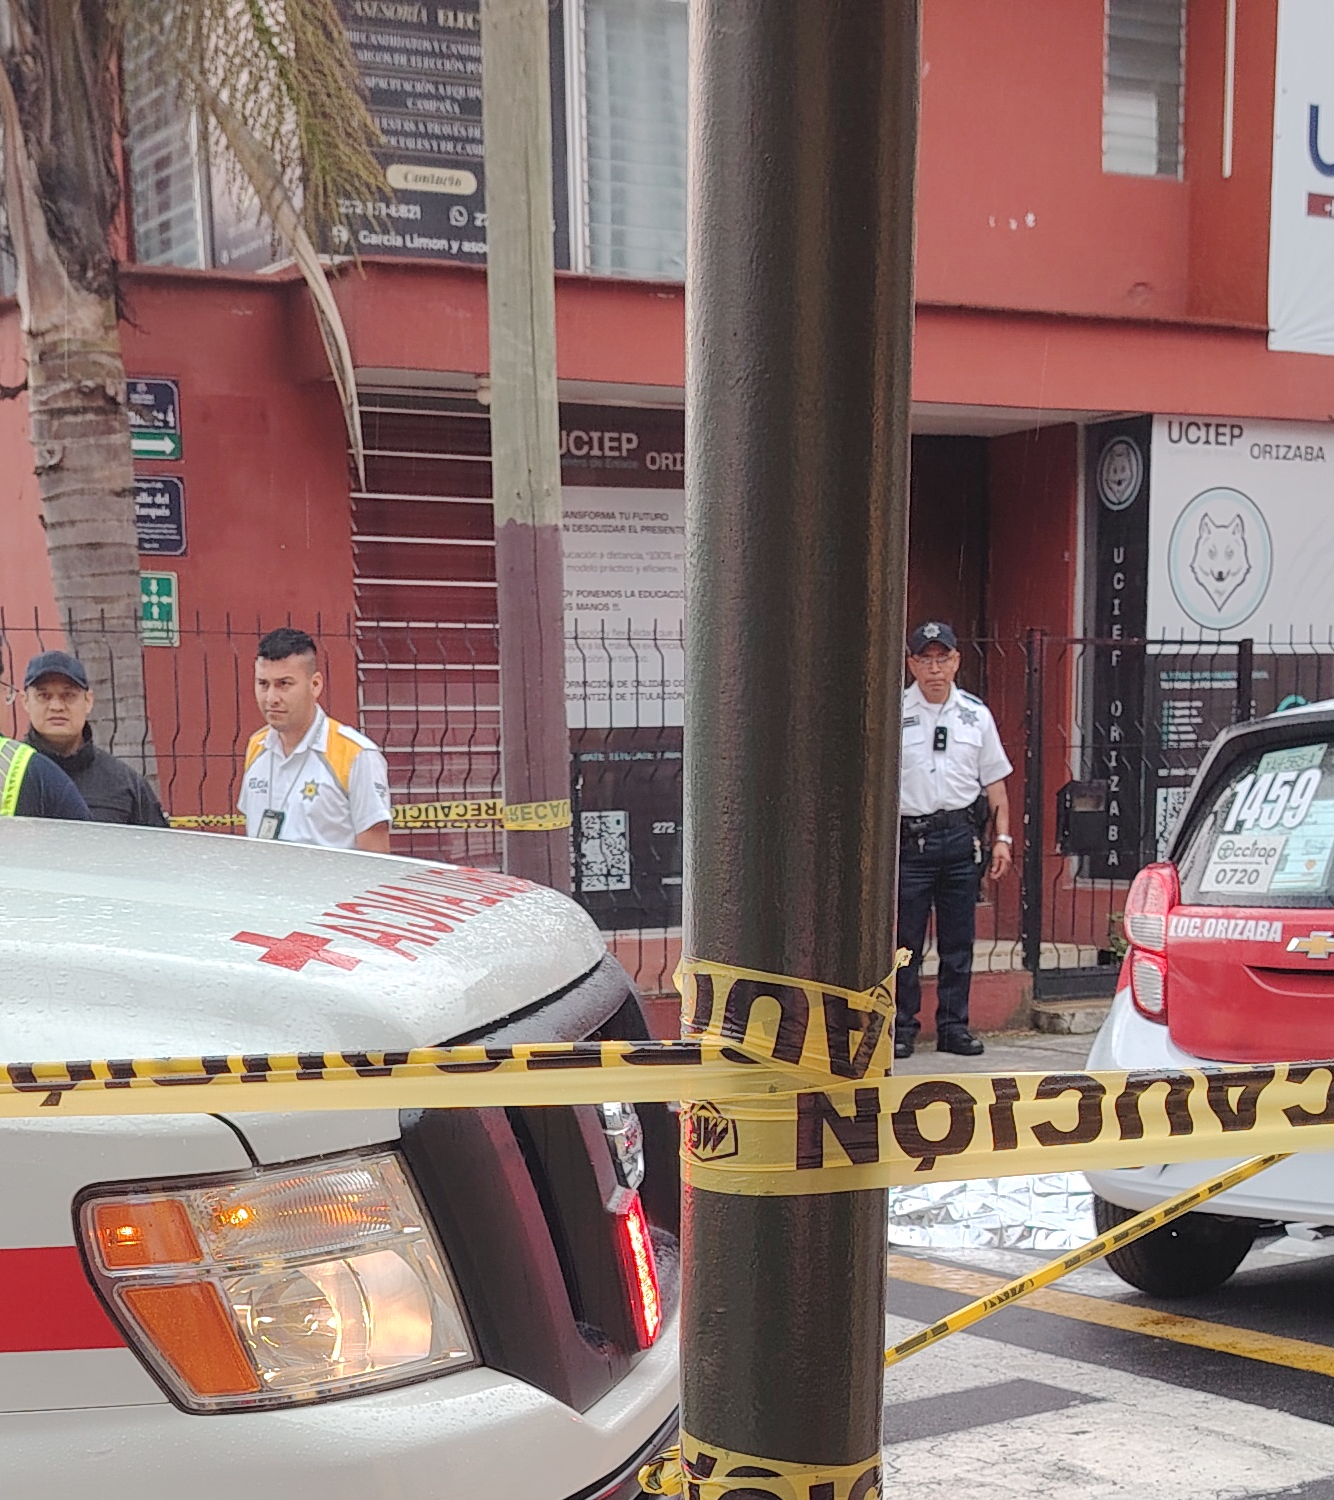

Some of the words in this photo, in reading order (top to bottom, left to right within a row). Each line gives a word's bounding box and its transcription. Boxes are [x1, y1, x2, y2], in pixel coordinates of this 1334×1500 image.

[1167, 420, 1244, 447] UCIEP
[1250, 442, 1326, 462] ORIZABA
[645, 451, 684, 471] ORI
[1223, 766, 1323, 832] 1459
[651, 821, 682, 834] 272-
[1214, 868, 1260, 885] 0720
